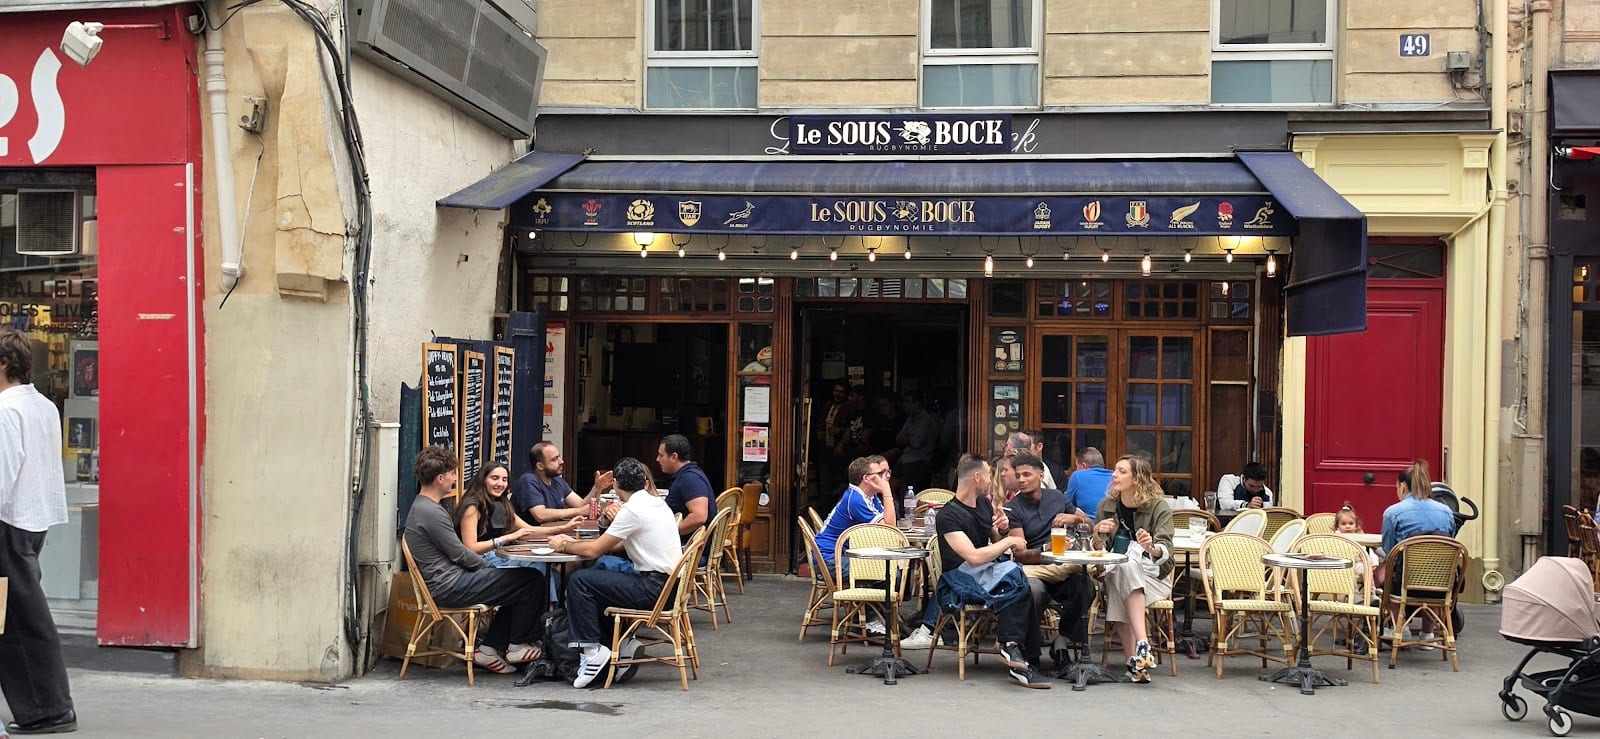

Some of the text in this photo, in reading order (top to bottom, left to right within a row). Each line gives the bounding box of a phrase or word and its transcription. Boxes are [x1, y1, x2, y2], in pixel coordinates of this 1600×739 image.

[1403, 35, 1427, 55] 49
[796, 119, 1004, 146] Le SOUS BOCK
[869, 144, 939, 152] RUGBYNOMIE
[811, 200, 975, 223] Le SOUS BOCK
[849, 224, 935, 232] RUGBYNOMIE
